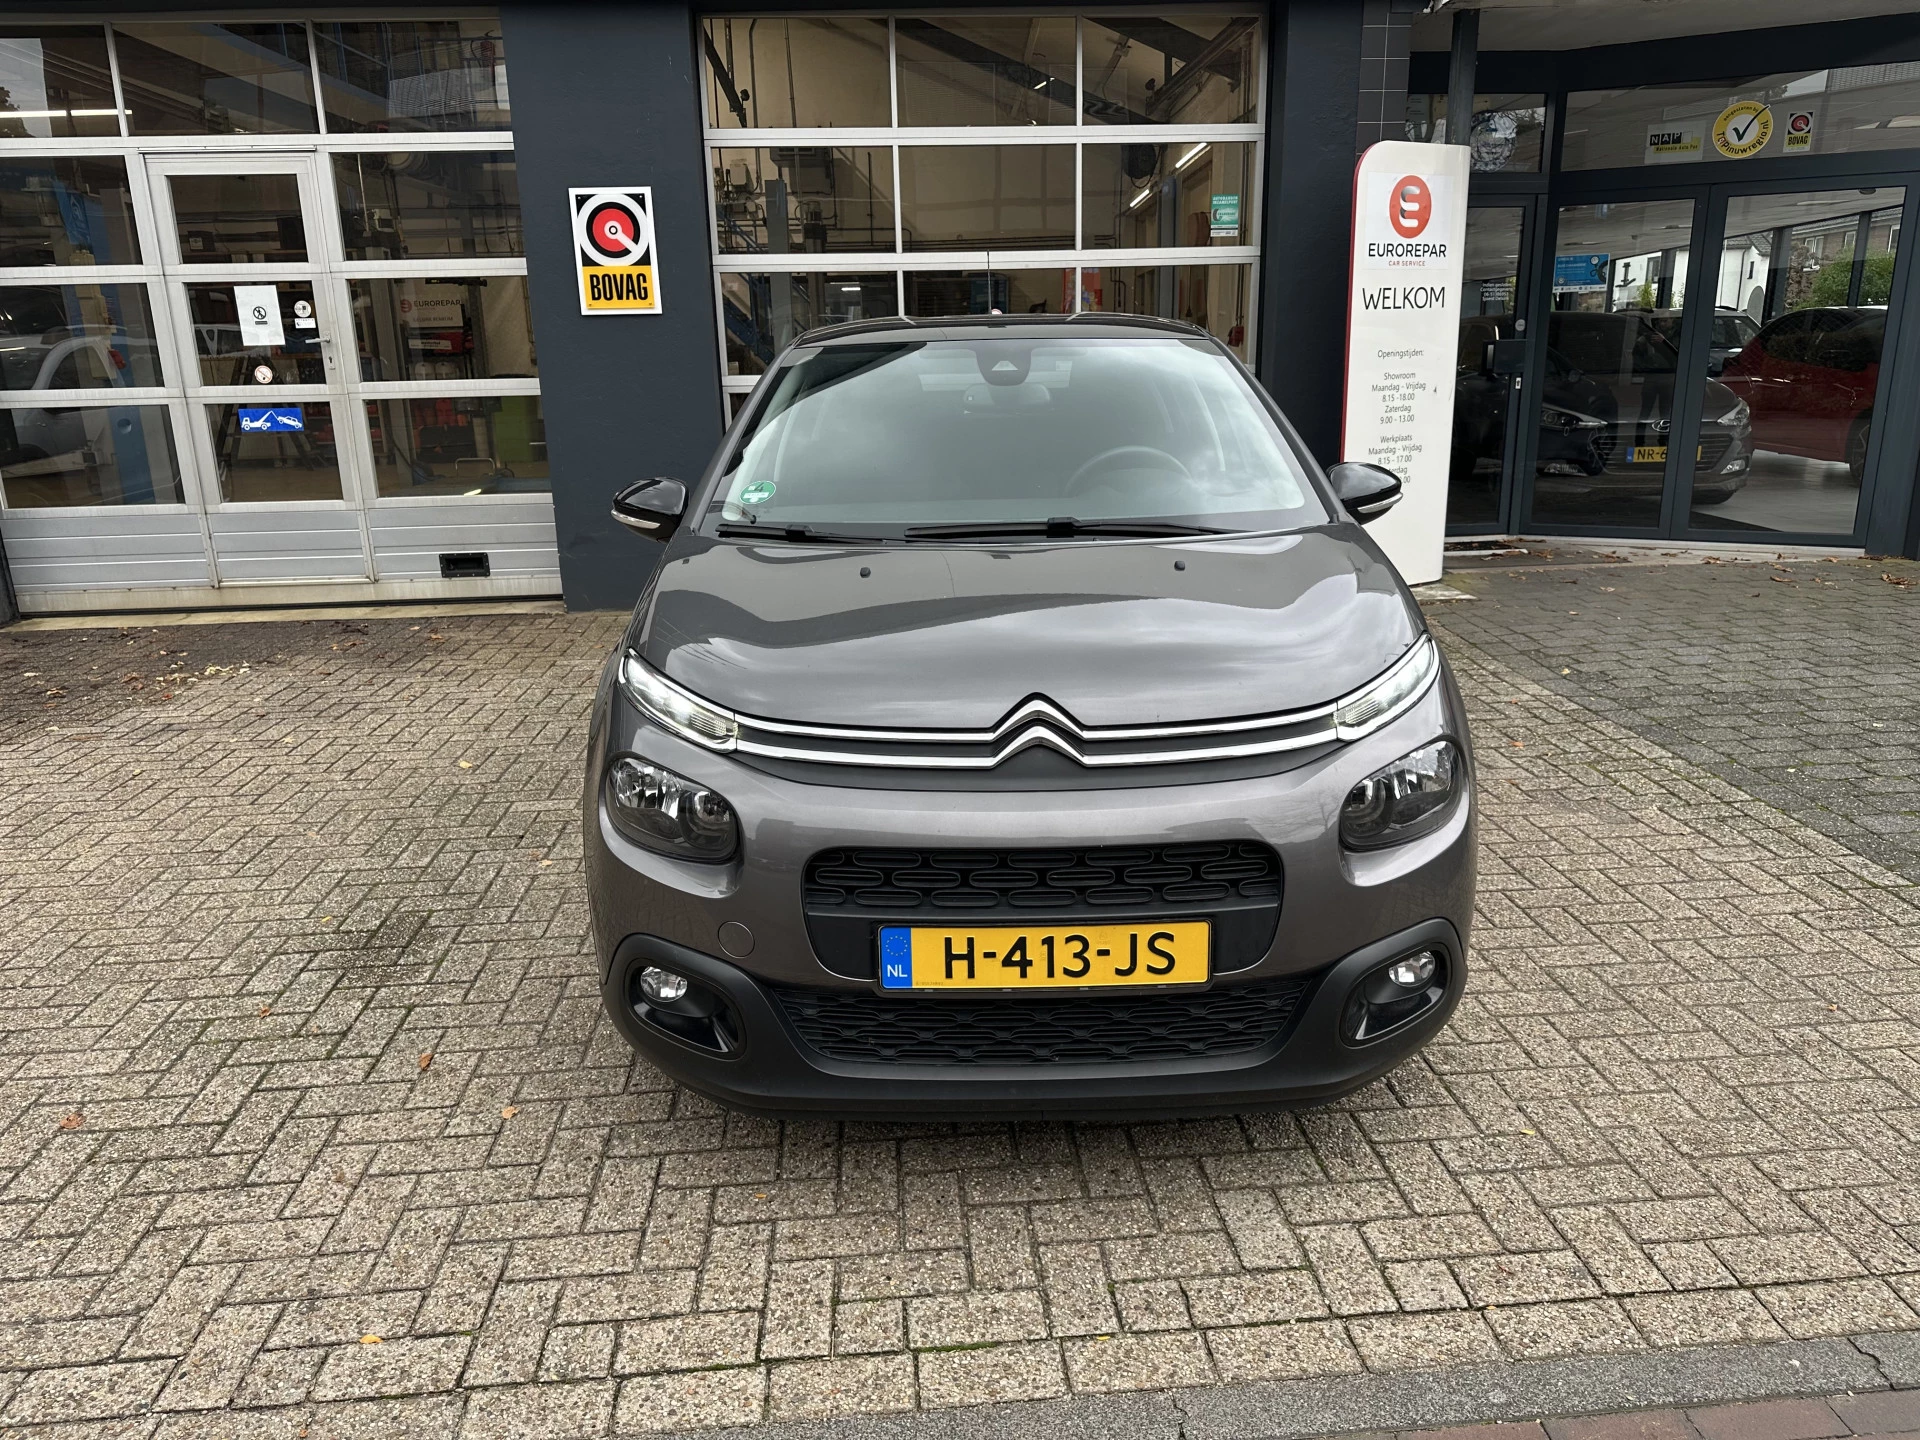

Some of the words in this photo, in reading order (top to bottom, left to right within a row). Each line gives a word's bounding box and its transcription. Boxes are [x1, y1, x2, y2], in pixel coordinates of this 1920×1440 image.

[1651, 132, 1682, 144] NAP
[1788, 135, 1809, 146] BOVAG
[1368, 242, 1447, 258] EUROREPAR
[589, 272, 649, 302] BOVAG
[414, 299, 462, 308] EUROREPAR
[1362, 286, 1446, 310] WELKOM
[1377, 349, 1424, 360] Openingstijden:
[1383, 372, 1416, 381] Showroom
[1371, 383, 1400, 393] Maandag
[1405, 382, 1427, 391] Vrijdag
[1384, 404, 1412, 414] Zaterdag
[1380, 416, 1393, 425] 9.00
[1398, 414, 1415, 423] 13.00
[1380, 433, 1413, 444] Werkplaats
[1368, 446, 1396, 457] Maandag
[1402, 443, 1423, 453] Vrijdag
[1637, 448, 1668, 461] NR-6
[1396, 454, 1413, 463] 17.00
[754, 482, 765, 493] 4
[944, 930, 1176, 979] H-413-JS
[887, 964, 908, 978] NL
